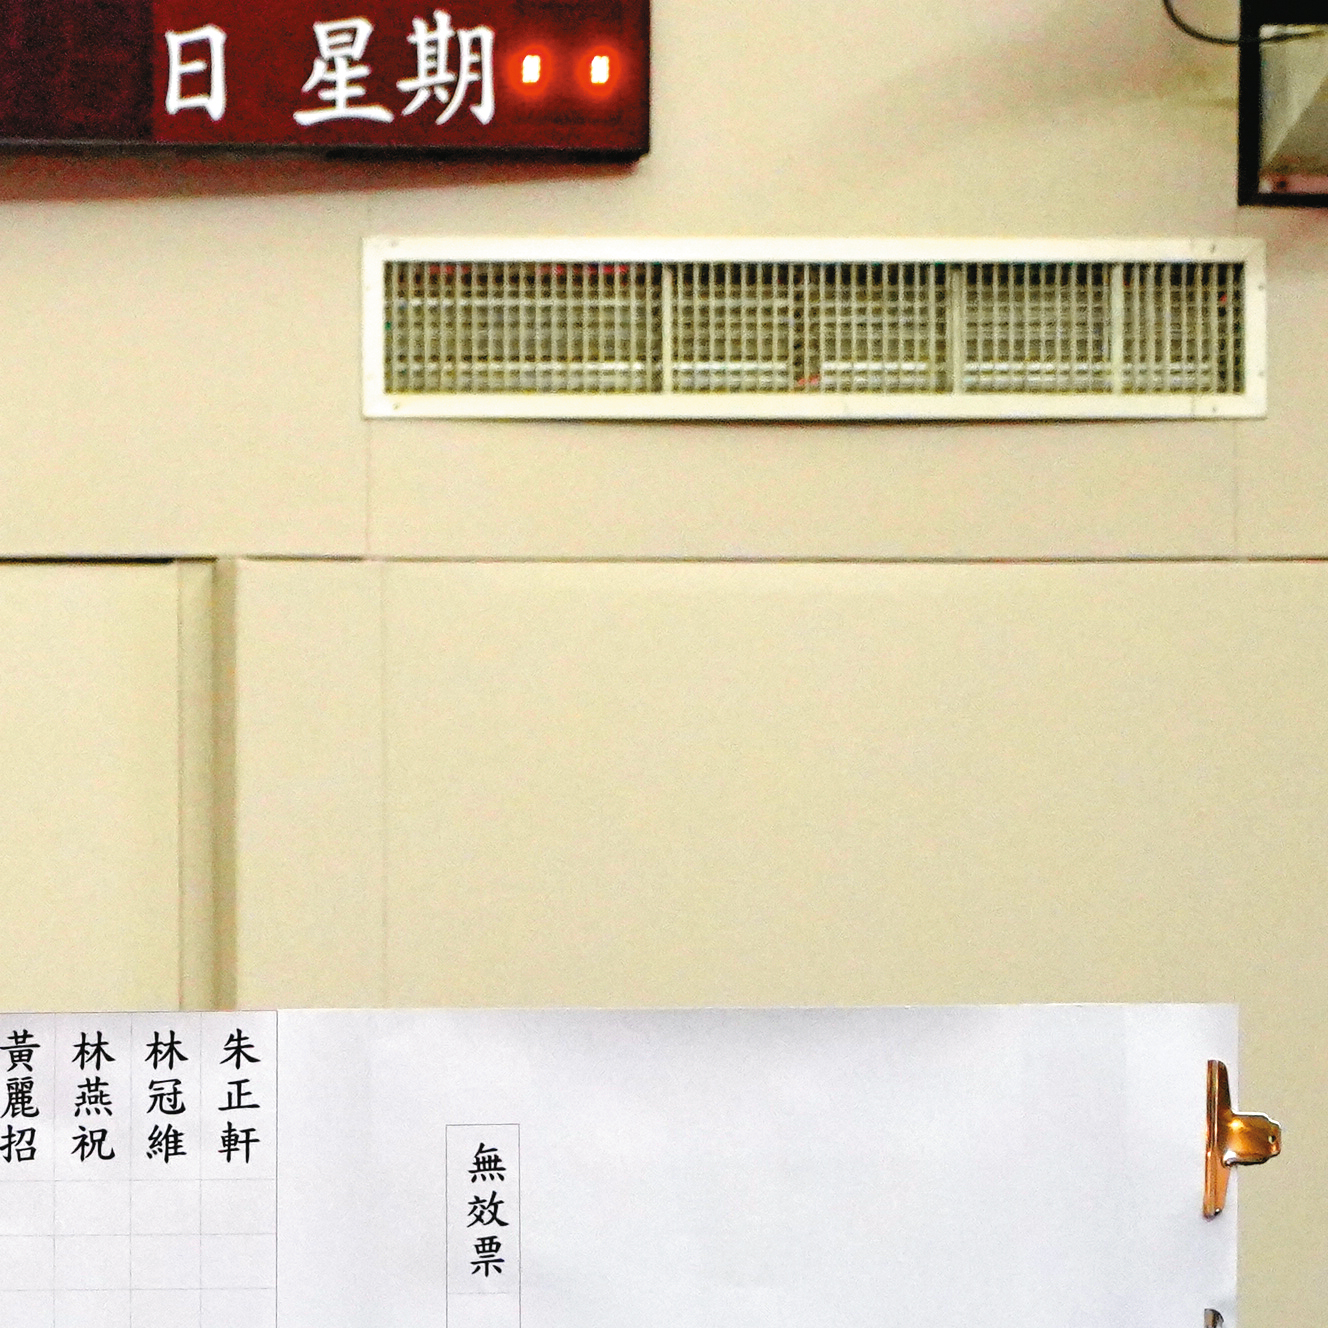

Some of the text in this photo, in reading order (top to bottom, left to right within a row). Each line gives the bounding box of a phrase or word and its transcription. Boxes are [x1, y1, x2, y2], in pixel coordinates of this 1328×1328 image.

[166, 26, 225, 120] 日
[294, 11, 494, 125] 星期
[0, 1030, 40, 1162] 黃麗招
[72, 1031, 115, 1161] 林燕祝
[146, 1030, 188, 1163] 林冠維
[219, 1029, 260, 1163] 朱正軒
[468, 1143, 508, 1276] 無效票
